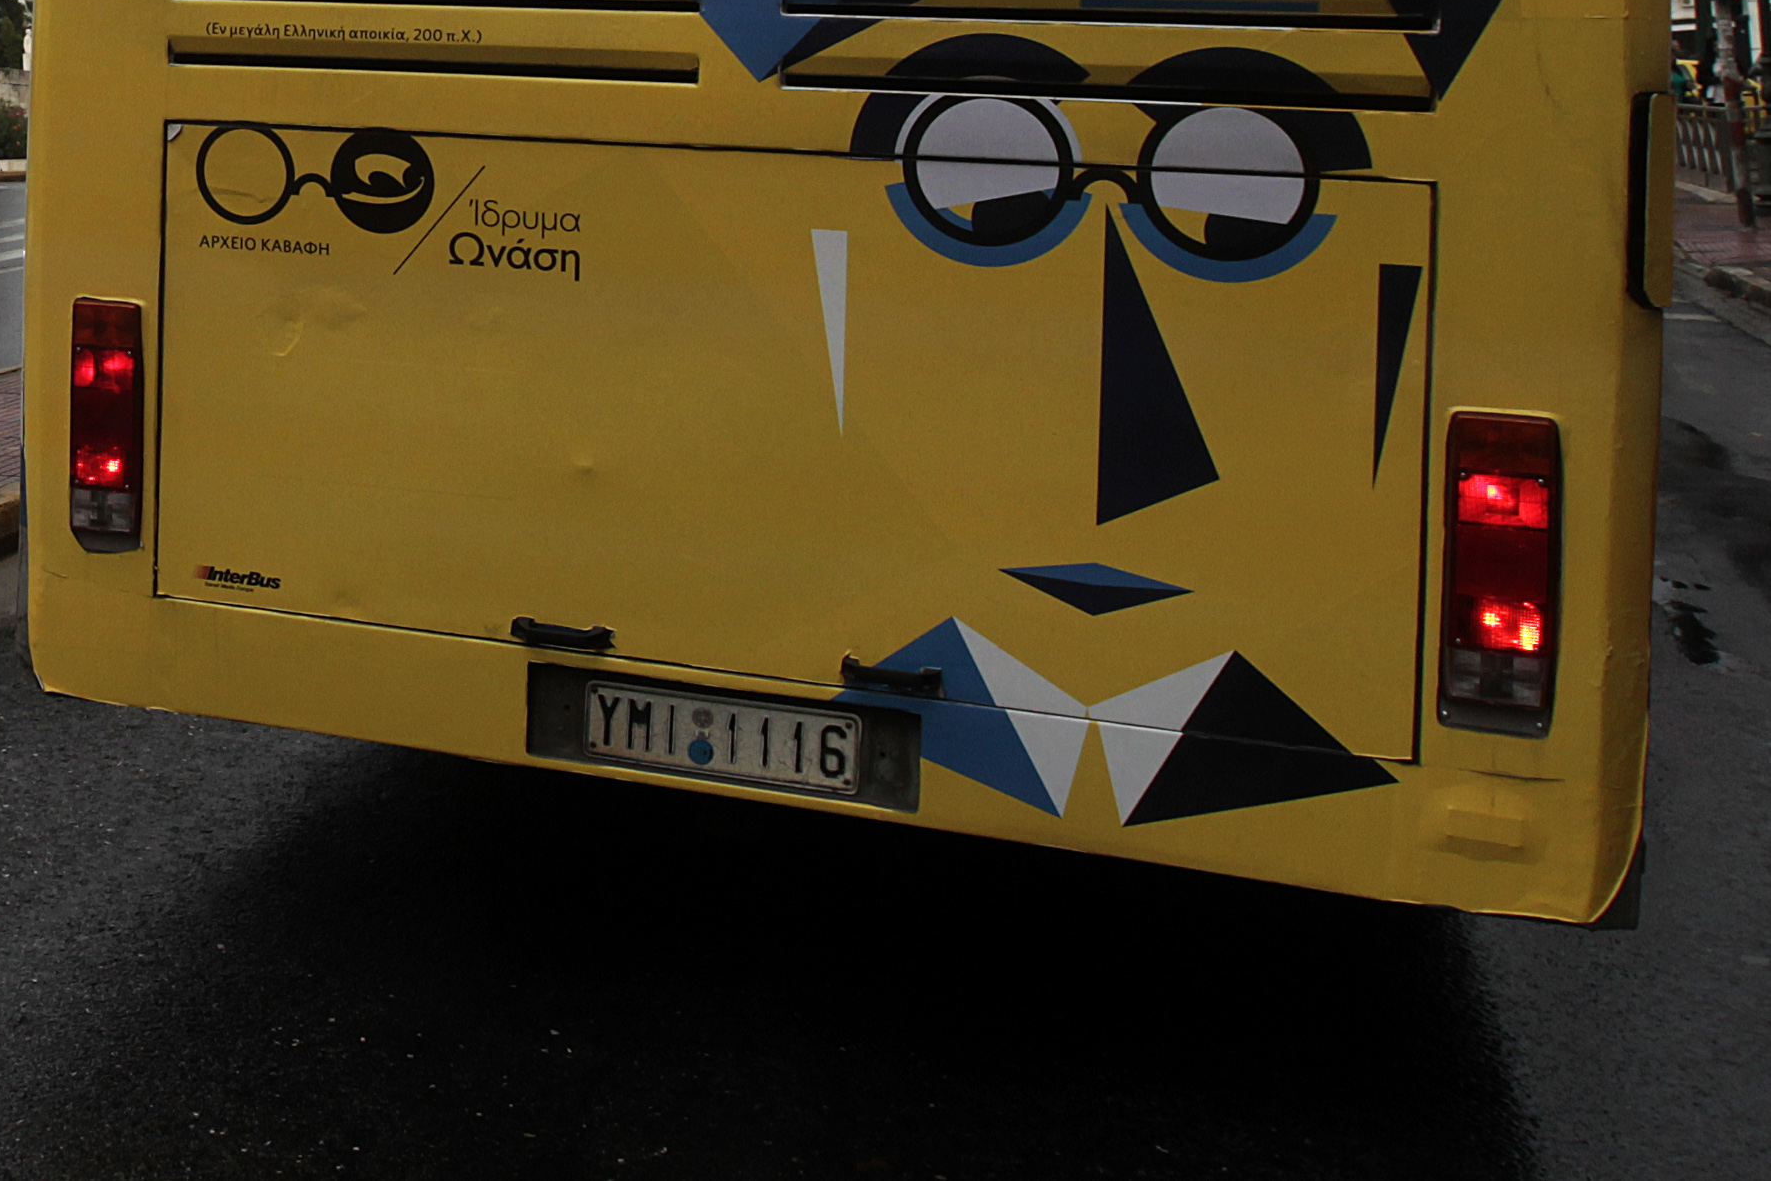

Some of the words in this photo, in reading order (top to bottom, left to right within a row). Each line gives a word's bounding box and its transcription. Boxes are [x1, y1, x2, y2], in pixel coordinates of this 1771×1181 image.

[205, 21, 227, 37] (Εν
[229, 24, 280, 39] μεγάλη
[284, 24, 346, 40] Ελληνική
[349, 28, 409, 43] αποικία,
[413, 28, 443, 42] 200
[468, 199, 581, 239] Ίδρυμα
[199, 234, 256, 252] ΑΡΧΕΙΟ
[261, 238, 330, 256] ΚΑΒΑΦΗ
[448, 231, 581, 282] Ωνάση
[207, 566, 281, 589] InterBus
